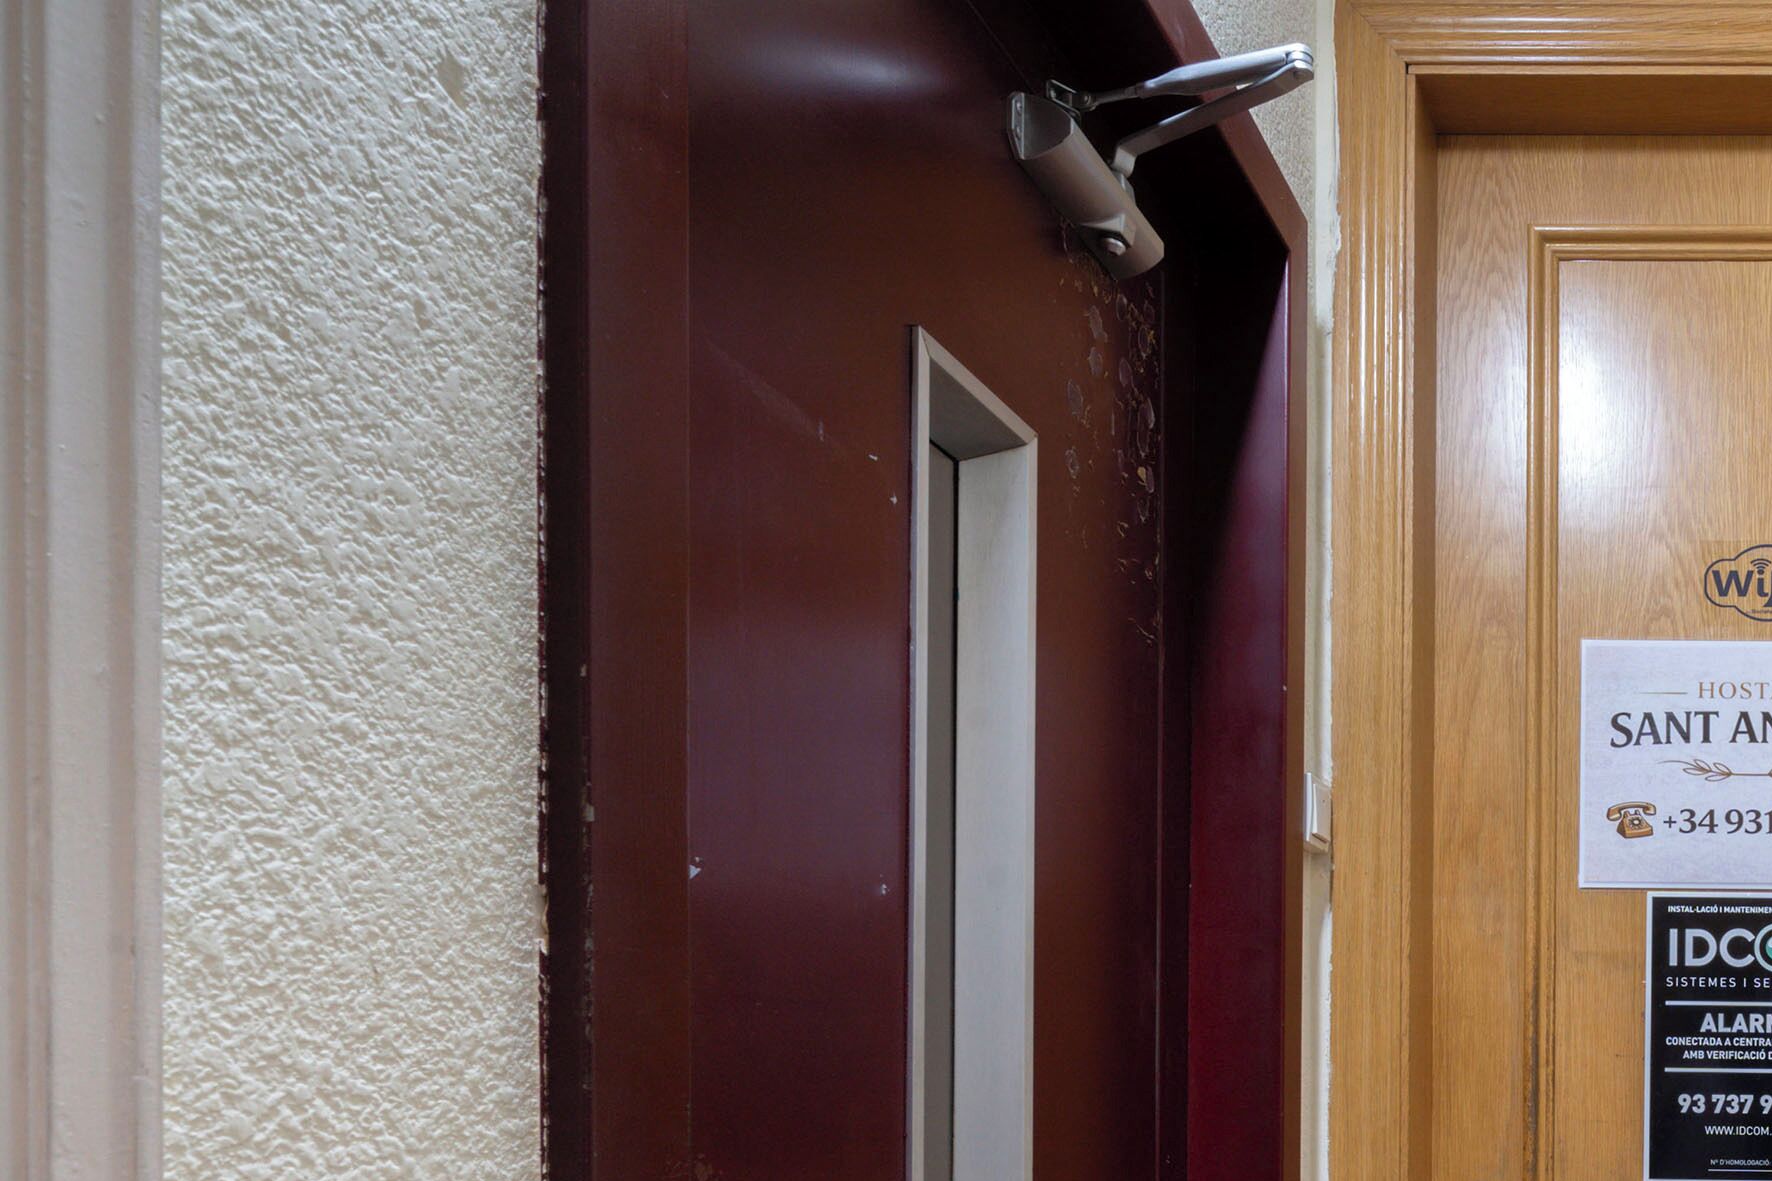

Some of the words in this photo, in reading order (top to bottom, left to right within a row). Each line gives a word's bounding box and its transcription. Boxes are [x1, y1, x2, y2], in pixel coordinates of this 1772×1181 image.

[1609, 710, 1719, 749] SANT
[1662, 808, 1719, 834] +34
[1665, 976, 1737, 988] SISTEMES
[1665, 1036, 1723, 1046] CONECTADA
[1724, 1037, 1732, 1046] A
[1682, 1050, 1705, 1060] AMB
[1706, 1048, 1766, 1060] VERIFICACIÓ
[1677, 1093, 1706, 1114] 93
[1711, 1093, 1754, 1115] 737
